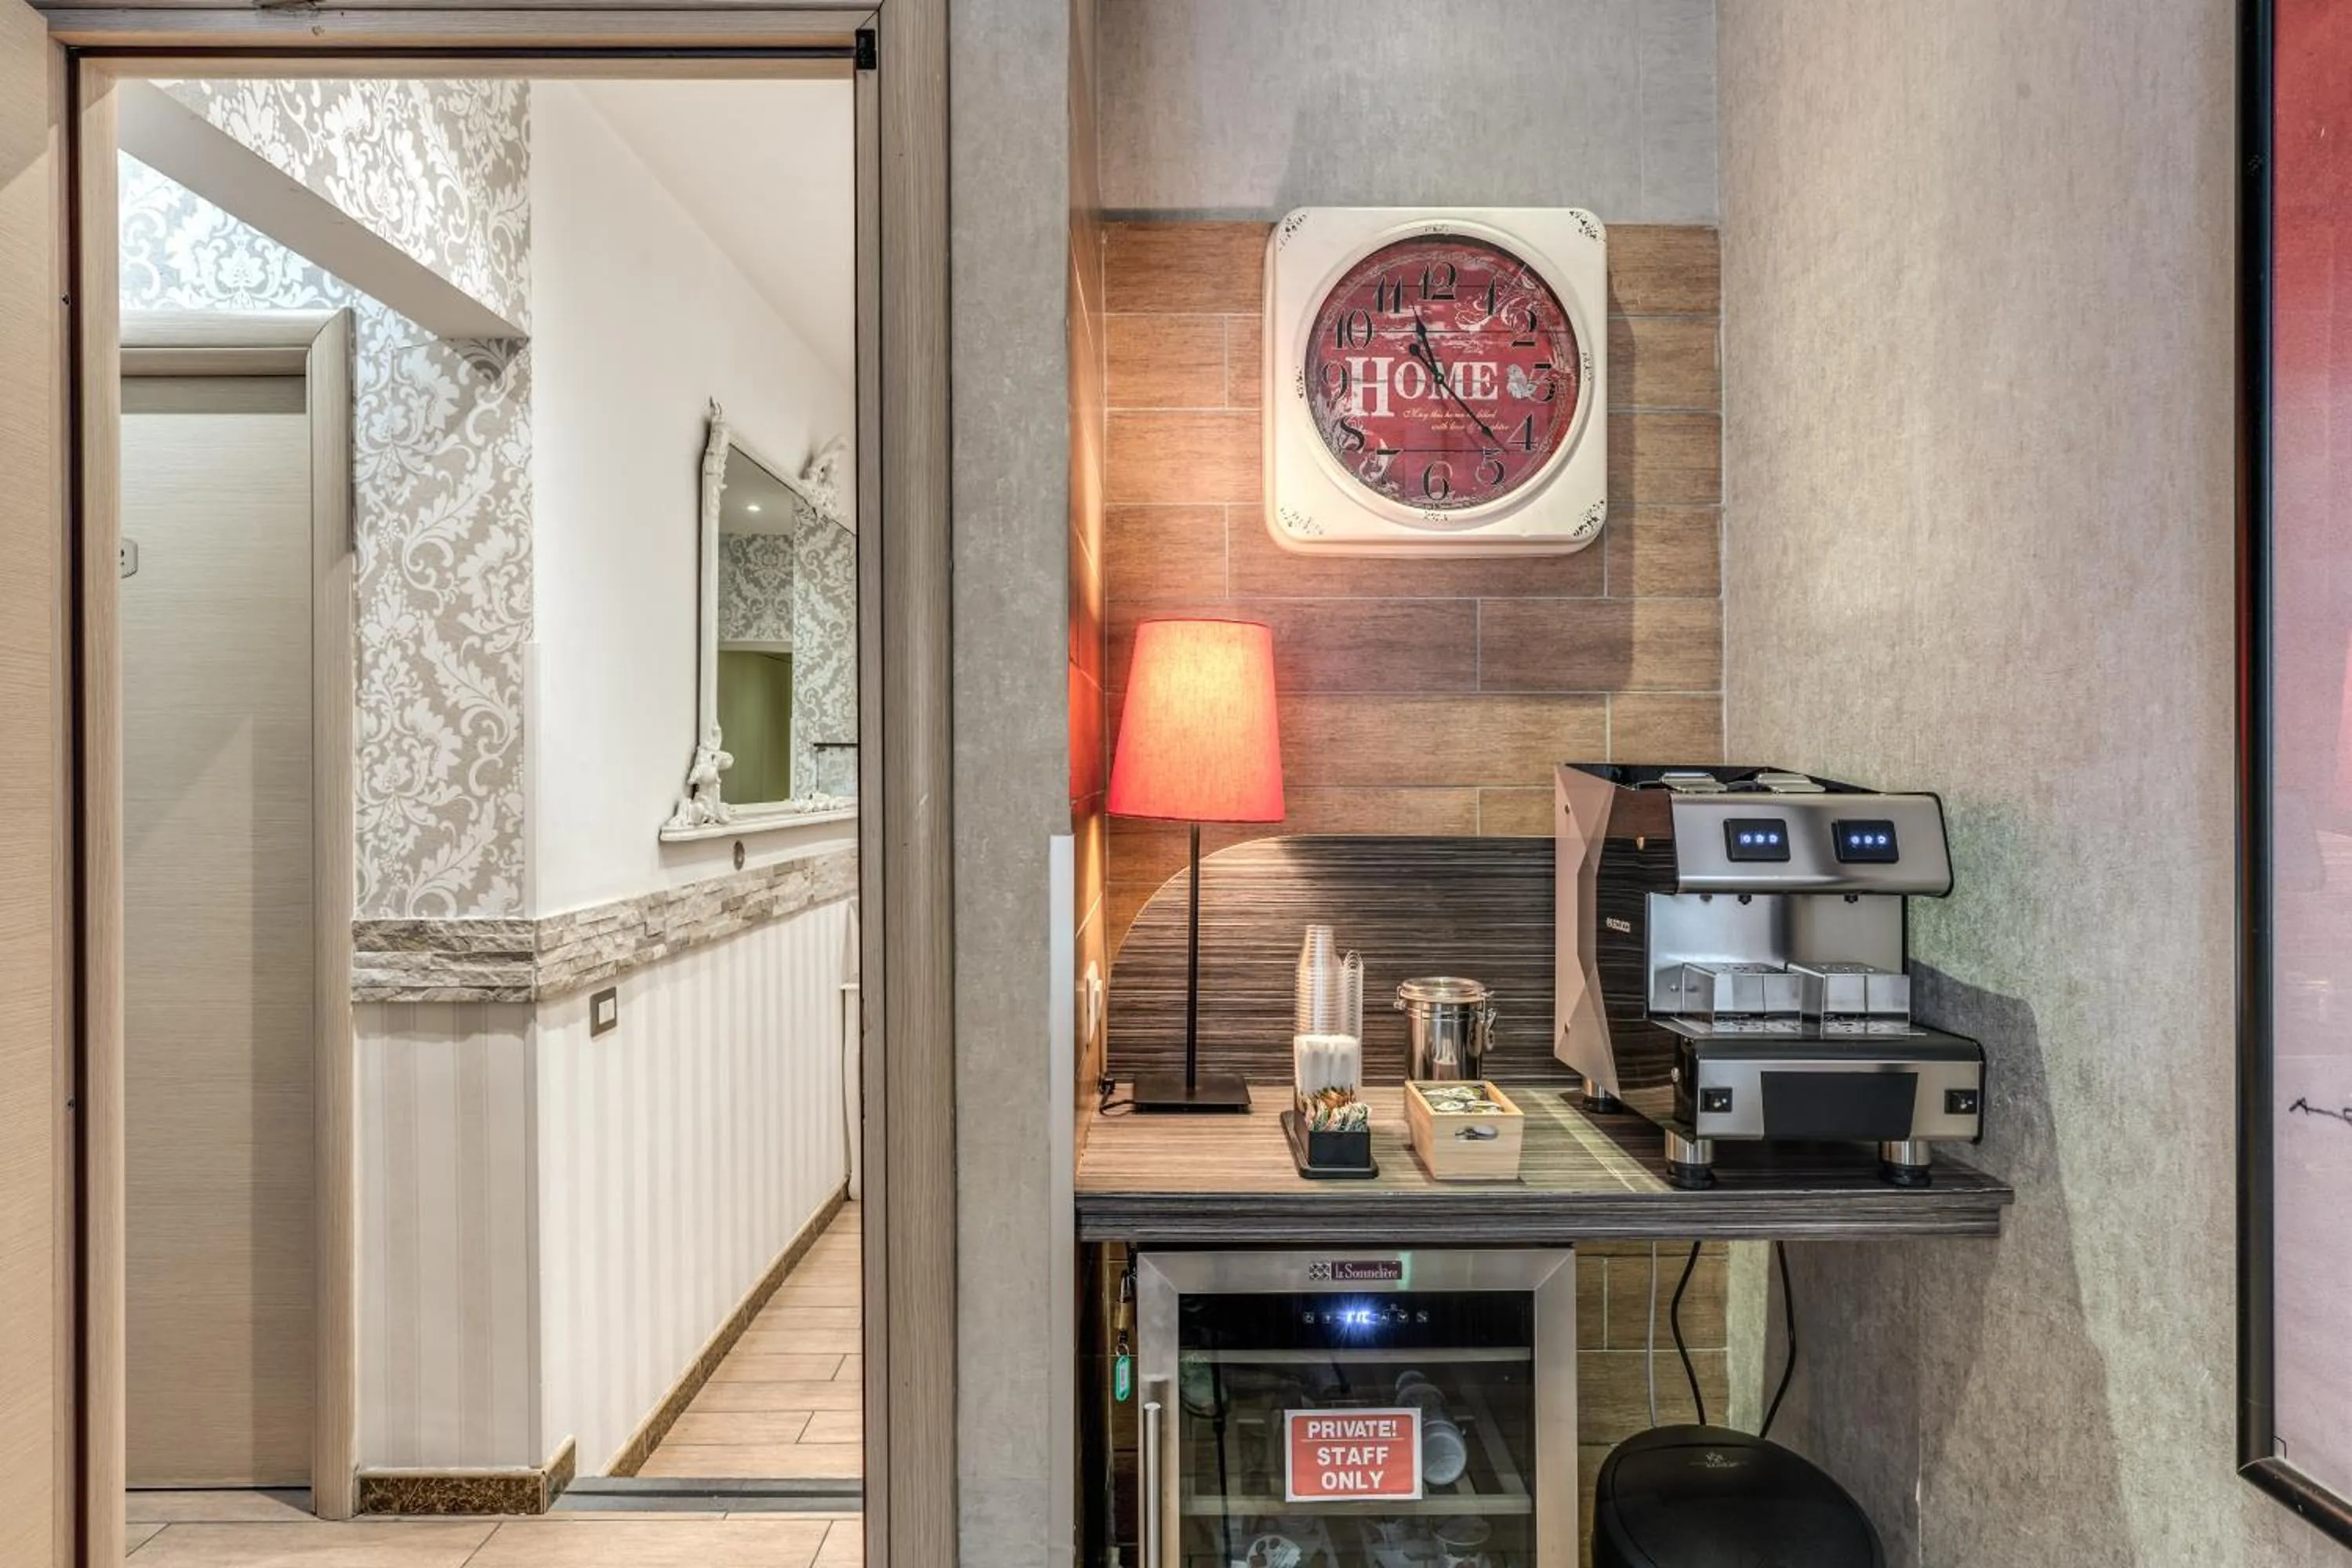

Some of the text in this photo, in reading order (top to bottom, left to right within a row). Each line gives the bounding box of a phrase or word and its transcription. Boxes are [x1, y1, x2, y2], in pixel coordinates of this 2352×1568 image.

[1373, 275, 1402, 314] 11
[1419, 261, 1457, 300] 12
[1333, 308, 1374, 351] 10
[1334, 416, 1365, 454] 8
[1507, 414, 1537, 452] 4
[1422, 461, 1453, 501] 6
[1475, 448, 1504, 486] 5
[1307, 1420, 1398, 1439] PRIVATE!
[1316, 1446, 1389, 1466] STAFF
[1321, 1470, 1385, 1490] ONLY
